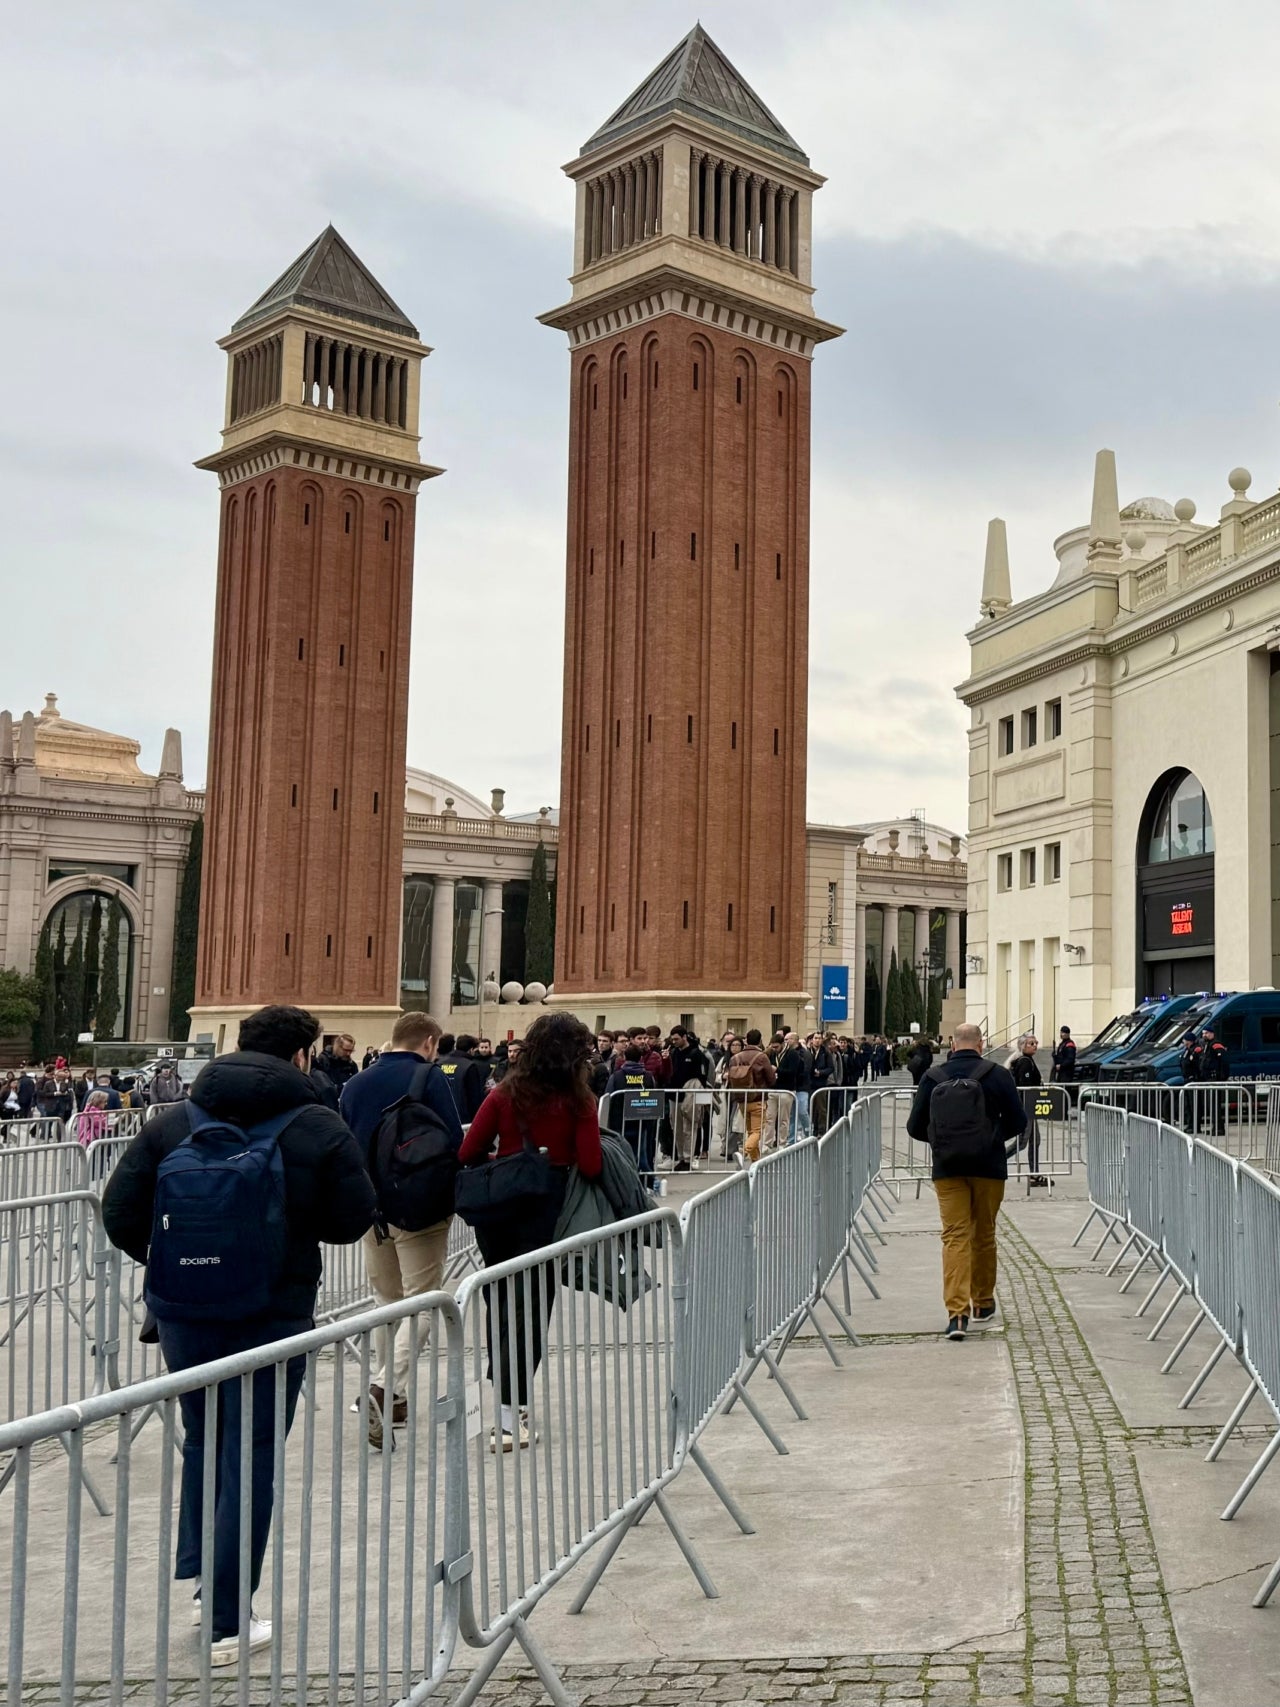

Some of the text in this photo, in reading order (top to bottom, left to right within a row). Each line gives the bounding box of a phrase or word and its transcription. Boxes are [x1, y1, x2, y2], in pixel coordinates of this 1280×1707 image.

[1228, 1073, 1253, 1082] ssos
[1035, 1104, 1053, 1115] 20'
[179, 1256, 221, 1266] axians
